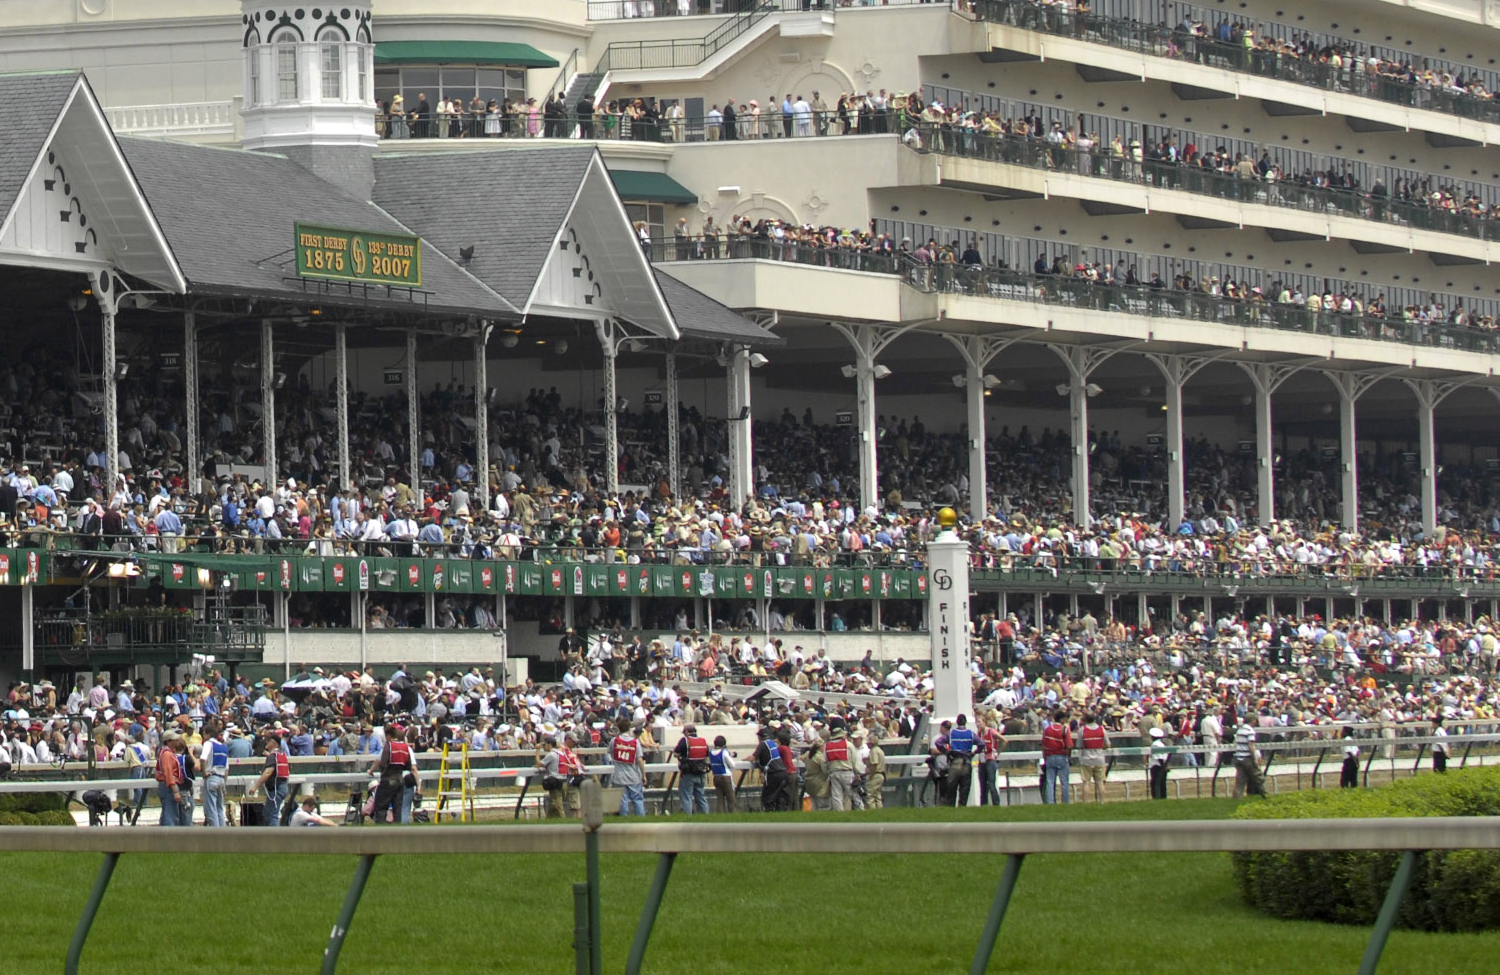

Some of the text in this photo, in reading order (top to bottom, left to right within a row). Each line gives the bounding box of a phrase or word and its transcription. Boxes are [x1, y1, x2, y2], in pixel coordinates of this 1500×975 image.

[300, 234, 347, 250] FIRST DERBY
[387, 244, 414, 257] DERBY
[305, 249, 344, 271] 1875
[372, 256, 410, 277] 2007
[939, 602, 950, 670] FINISH
